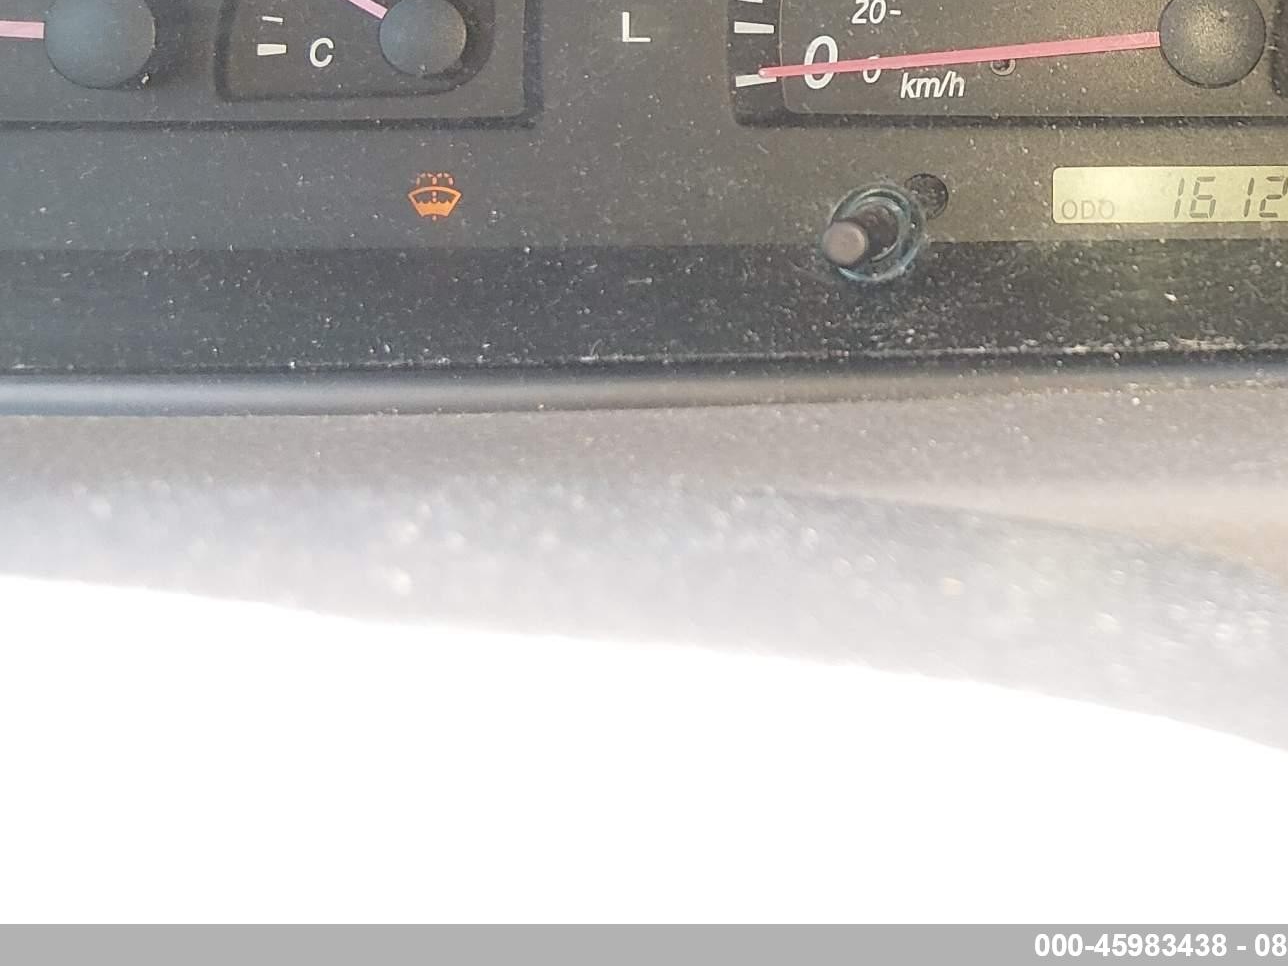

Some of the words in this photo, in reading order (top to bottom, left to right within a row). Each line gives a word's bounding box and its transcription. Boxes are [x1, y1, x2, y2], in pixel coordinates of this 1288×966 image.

[622, 12, 651, 42] L
[309, 37, 334, 67] C
[804, 35, 839, 90] 0
[900, 70, 965, 99] km/h
[1061, 200, 1115, 220] ODO
